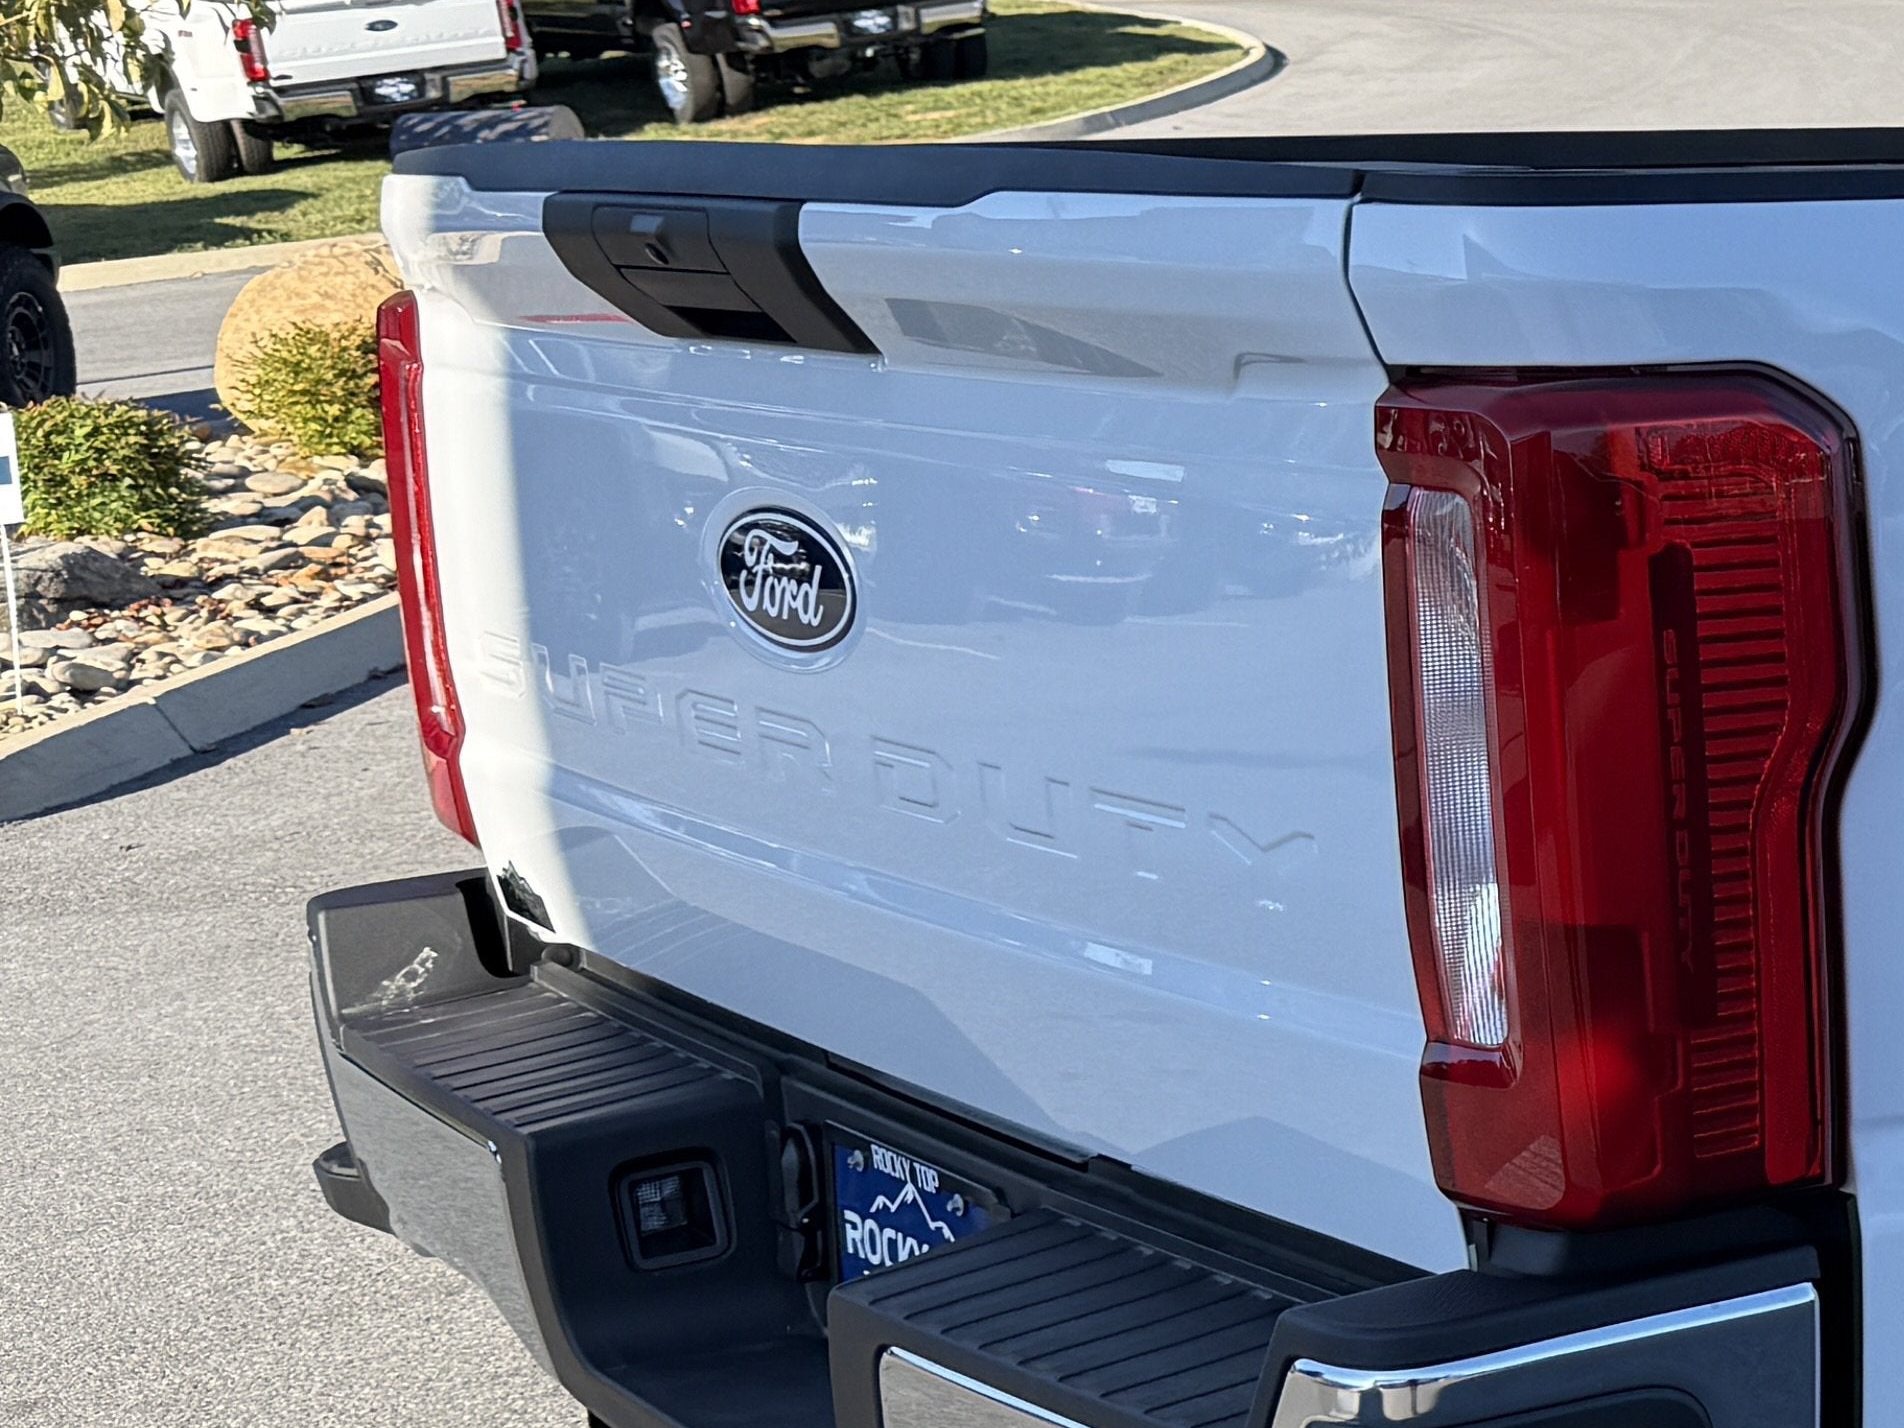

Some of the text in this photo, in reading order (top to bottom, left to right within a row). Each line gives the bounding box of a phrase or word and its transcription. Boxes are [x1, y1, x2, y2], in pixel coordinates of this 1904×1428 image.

[740, 528, 824, 627] Ford
[478, 632, 1320, 909] SUPER DUTY
[870, 1143, 940, 1194] ROCKY TOP
